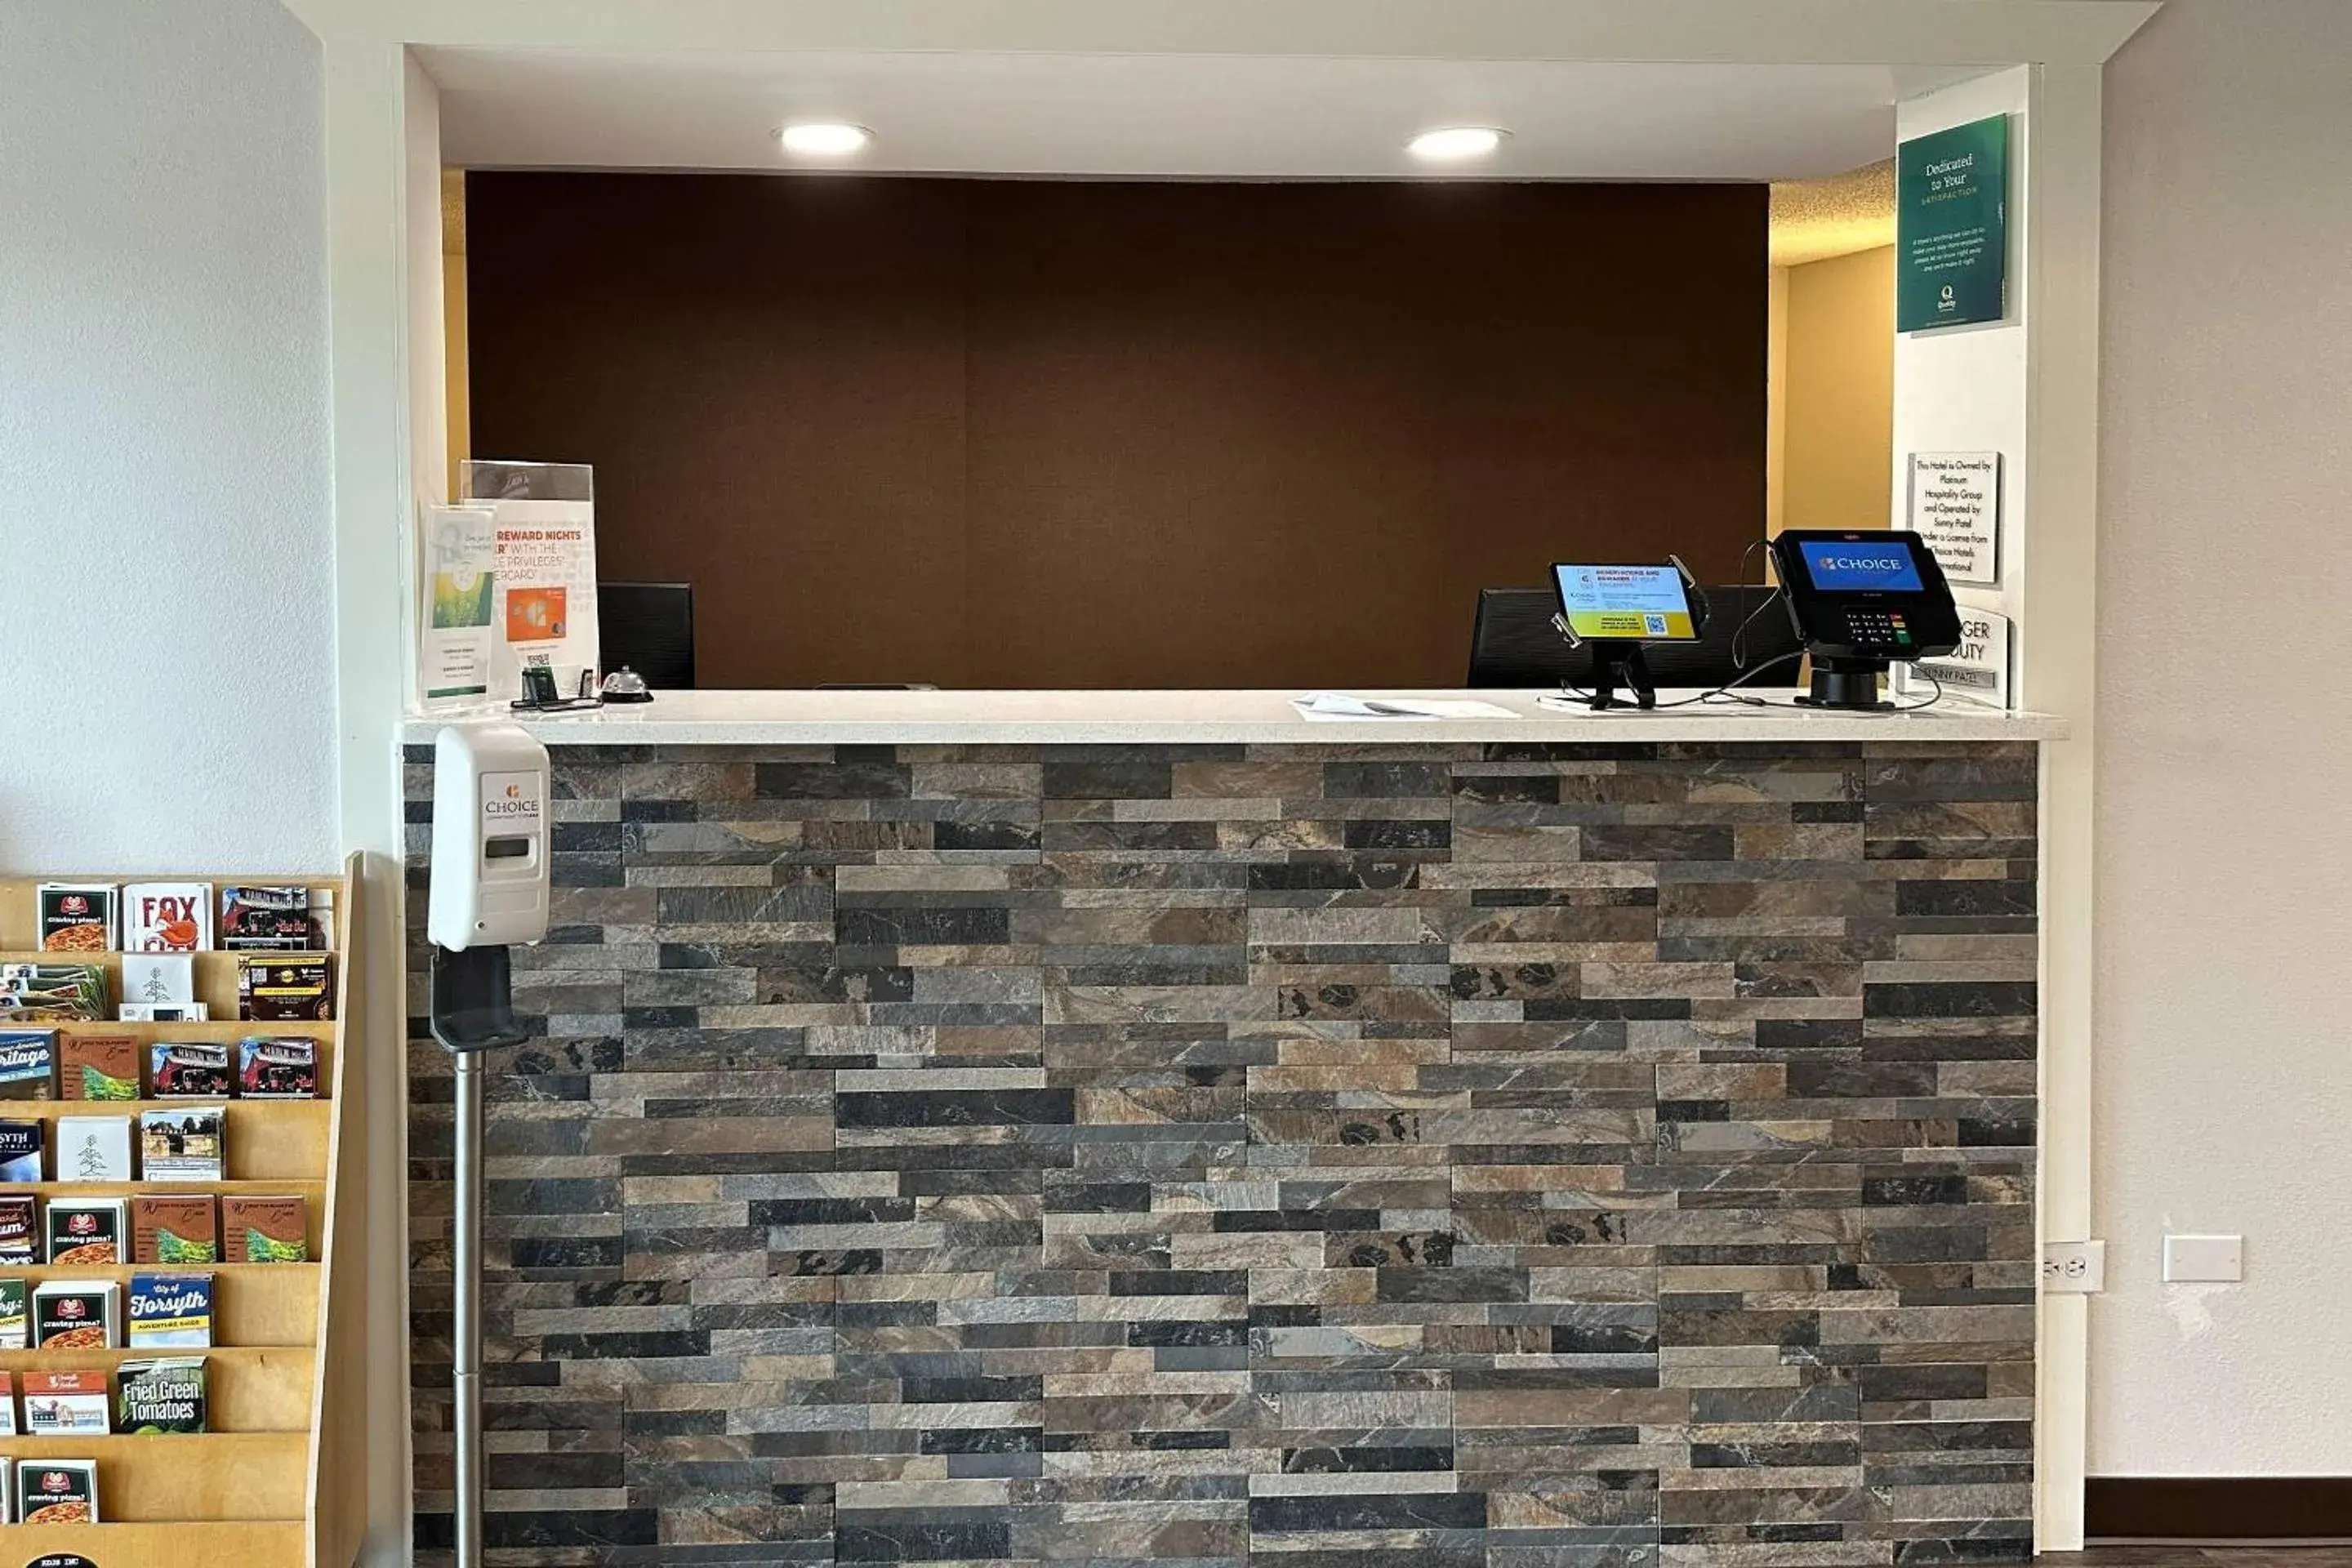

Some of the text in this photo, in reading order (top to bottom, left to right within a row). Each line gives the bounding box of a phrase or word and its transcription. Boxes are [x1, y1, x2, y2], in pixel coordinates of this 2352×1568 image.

[1926, 153, 1973, 176] Dedicated
[1944, 174, 1967, 188] Your
[1930, 460, 1948, 470] Hotel
[1955, 460, 1981, 470] Owned
[1981, 459, 1993, 473] by
[1960, 488, 1983, 501] Group
[1923, 501, 1937, 513] and
[1938, 502, 1971, 514] Operated
[1934, 517, 1954, 529] Sunny
[497, 531, 581, 541] REWARD NIGHTS
[1837, 558, 1902, 570] CHOICE
[485, 801, 538, 813] CHOICE
[142, 897, 199, 928] FOX
[55, 1234, 85, 1244] craving
[131, 1291, 207, 1316] Forsyth
[43, 1320, 74, 1329] craving
[123, 1380, 198, 1401] Fried Green
[130, 1400, 194, 1421] Tomatoes
[27, 1494, 59, 1503] craving
